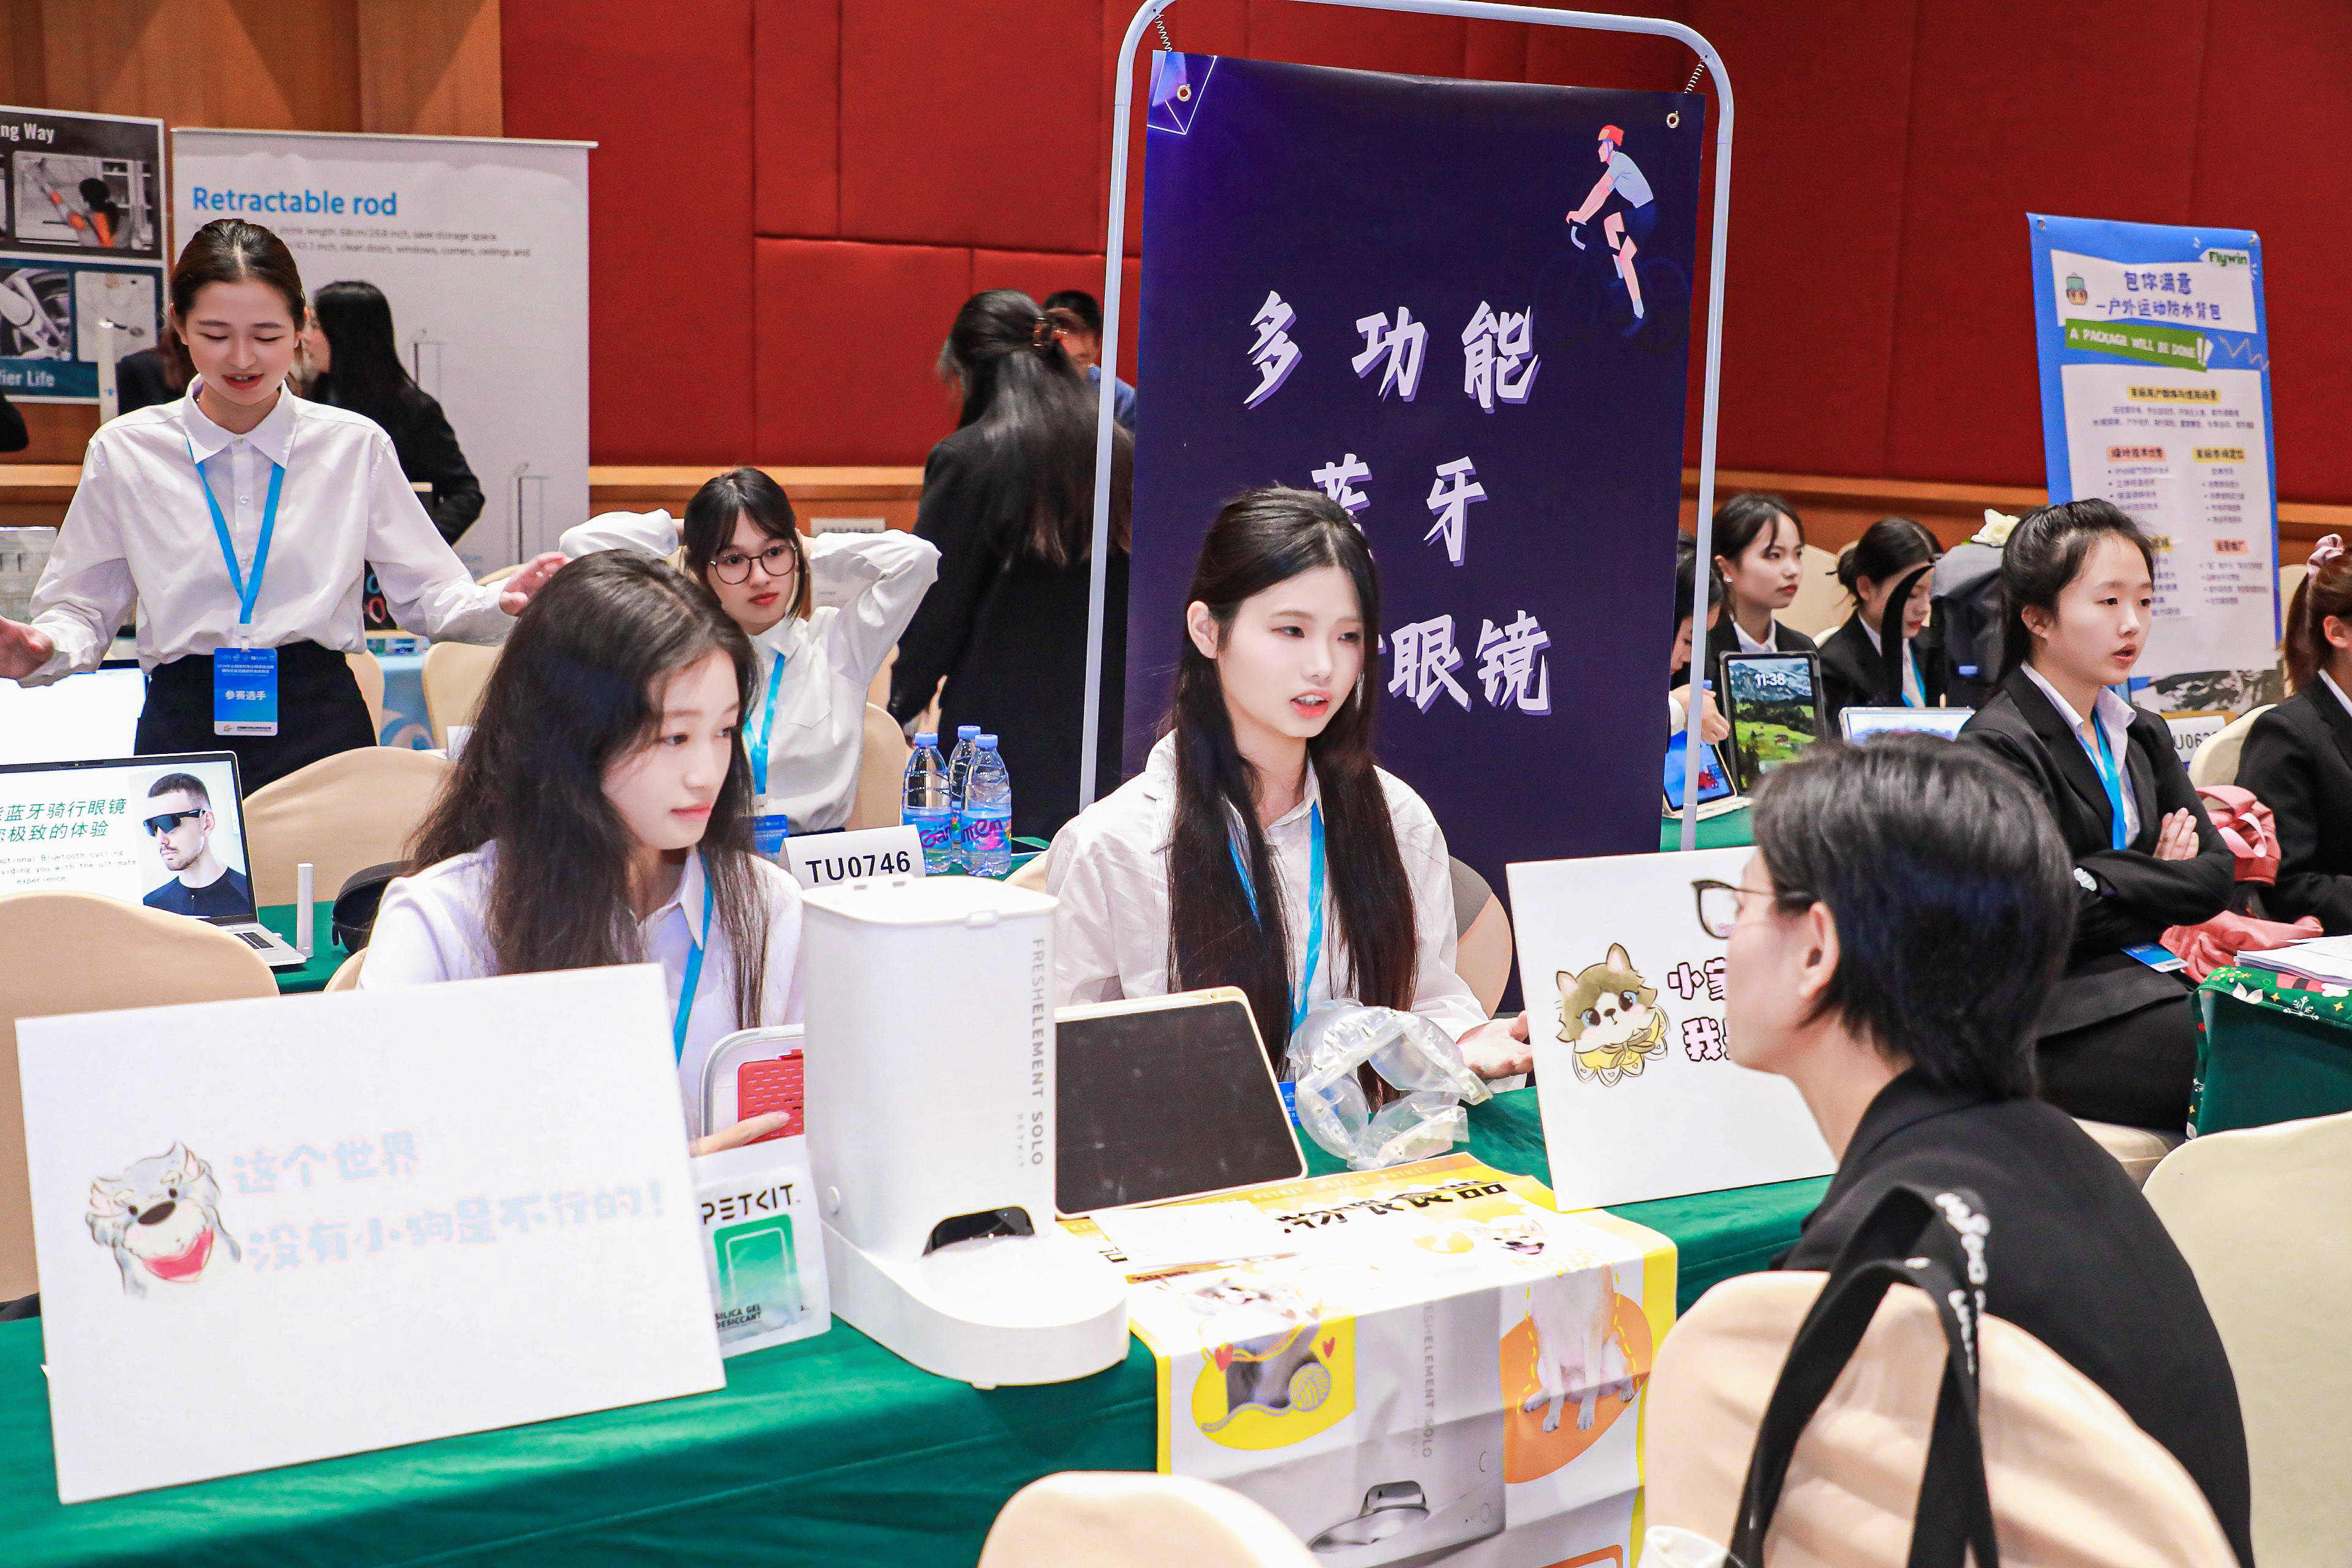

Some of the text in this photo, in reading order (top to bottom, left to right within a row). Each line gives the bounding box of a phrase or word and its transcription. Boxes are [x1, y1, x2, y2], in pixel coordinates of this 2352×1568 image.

[23, 123, 55, 144] Way
[192, 186, 398, 216] Retractable rod
[2208, 250, 2248, 267] Flywin
[2070, 326, 2079, 340] A
[1243, 290, 1541, 413] 多功能
[26, 369, 56, 387] Life
[1379, 610, 1551, 715] 眼镜
[1755, 673, 1787, 687] 11:38
[225, 690, 267, 701] 参赛选手
[41, 852, 86, 861] Bluetooth
[89, 850, 124, 859] cycling
[36, 865, 50, 874] you
[99, 859, 137, 868] ultimate
[805, 850, 911, 884] TU0746
[17, 875, 66, 886] experience
[1682, 1016, 1731, 1062] 我
[1031, 938, 1045, 1166] FRESHELEMENT SOLO
[230, 1130, 421, 1196] 这个世界
[701, 1183, 794, 1225] PETKIT
[746, 1303, 761, 1313] GEL
[1422, 1418, 1434, 1458] SOLO
